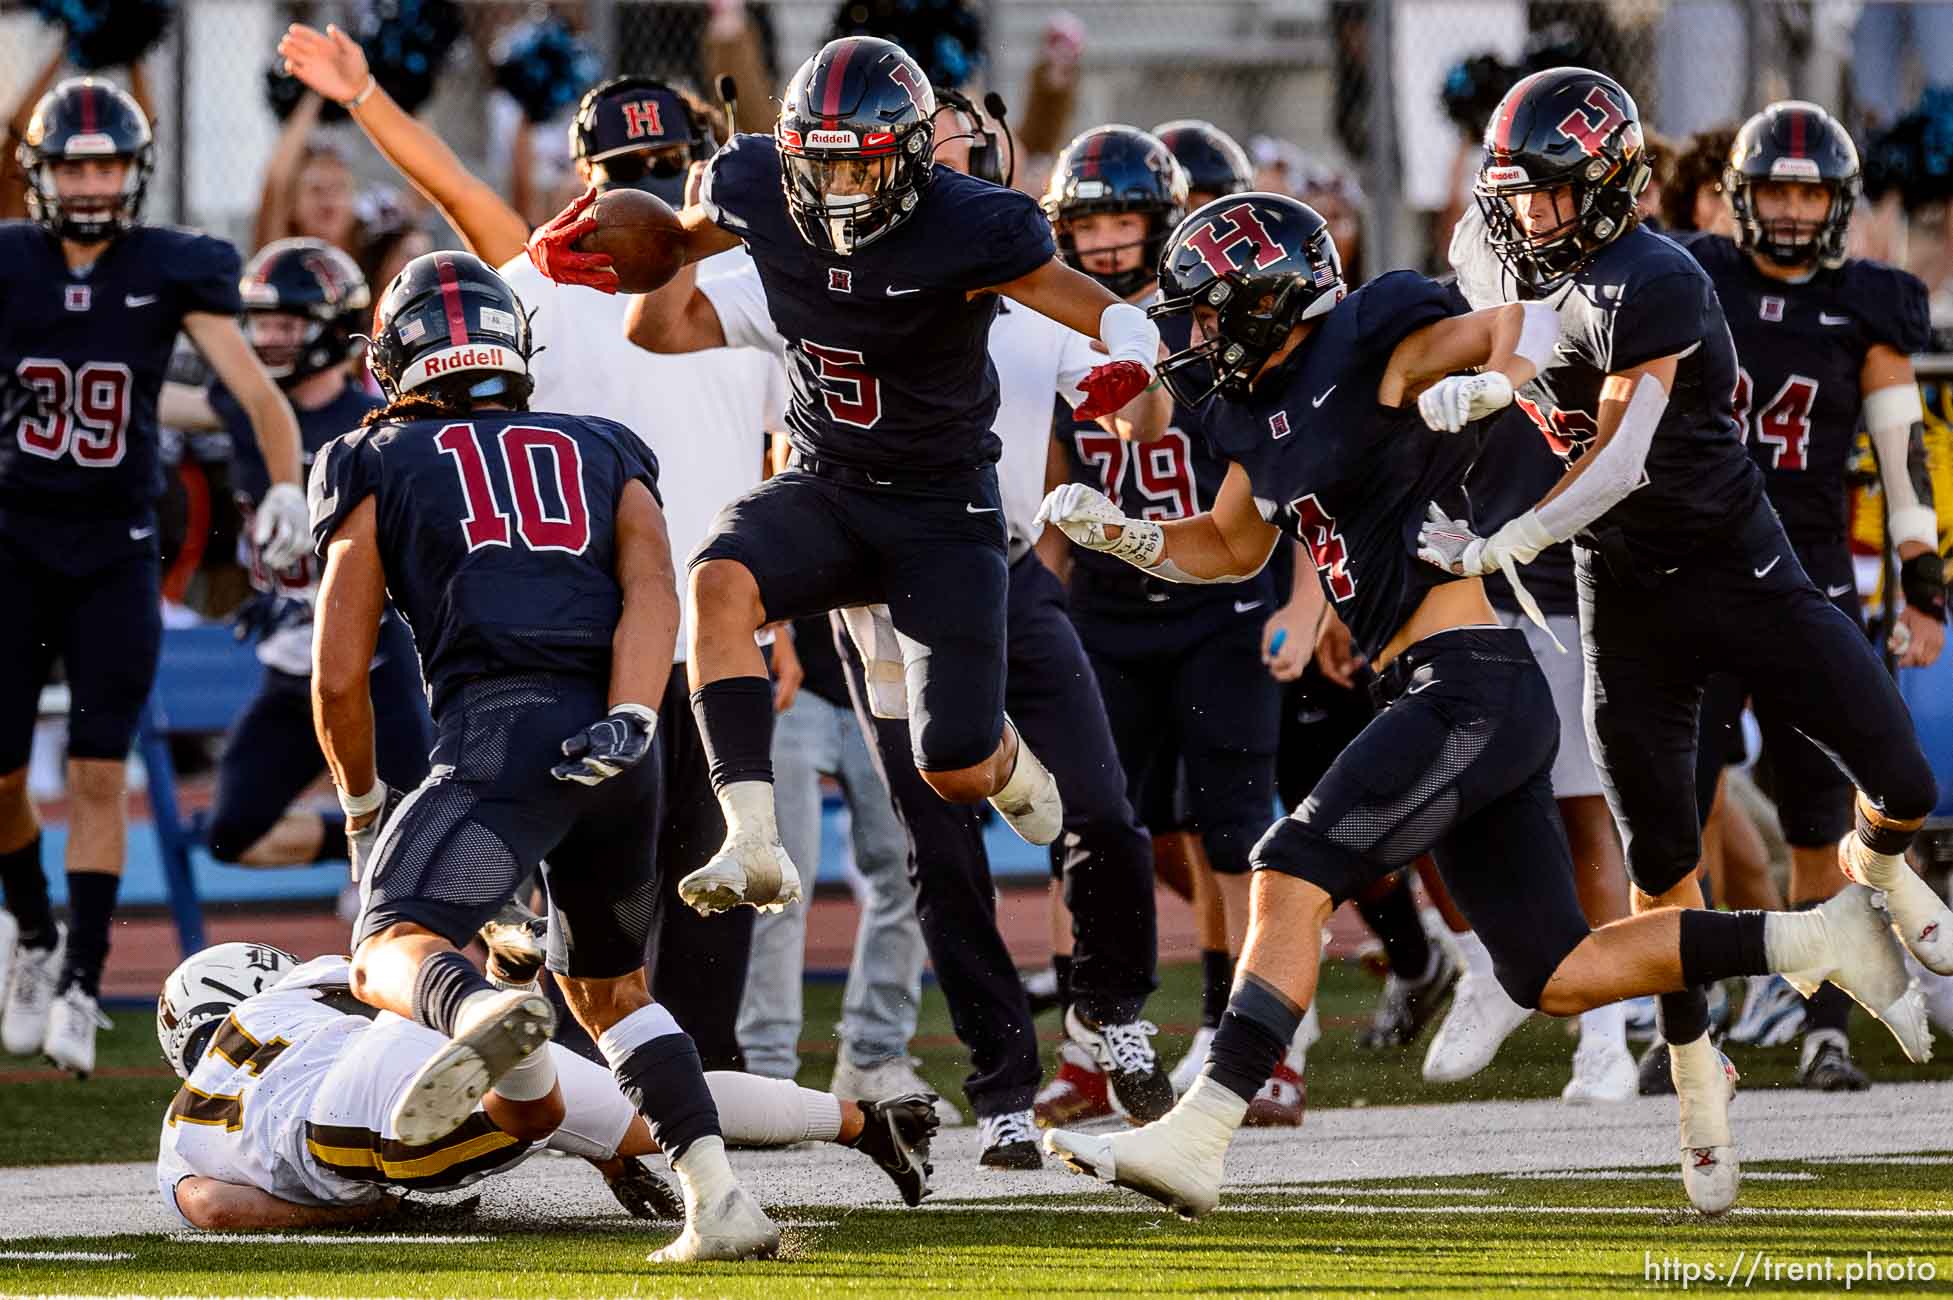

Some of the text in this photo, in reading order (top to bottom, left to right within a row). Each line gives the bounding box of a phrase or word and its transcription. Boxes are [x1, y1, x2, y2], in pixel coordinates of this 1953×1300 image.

[622, 101, 664, 139] H
[811, 133, 850, 143] Riddell
[828, 268, 852, 293] H
[1182, 203, 1288, 278] H
[424, 349, 503, 376] Riddell
[801, 338, 882, 429] 5
[16, 357, 132, 467] 39
[433, 423, 590, 556] 10
[1074, 427, 1200, 521] 79
[1290, 493, 1355, 603] 4
